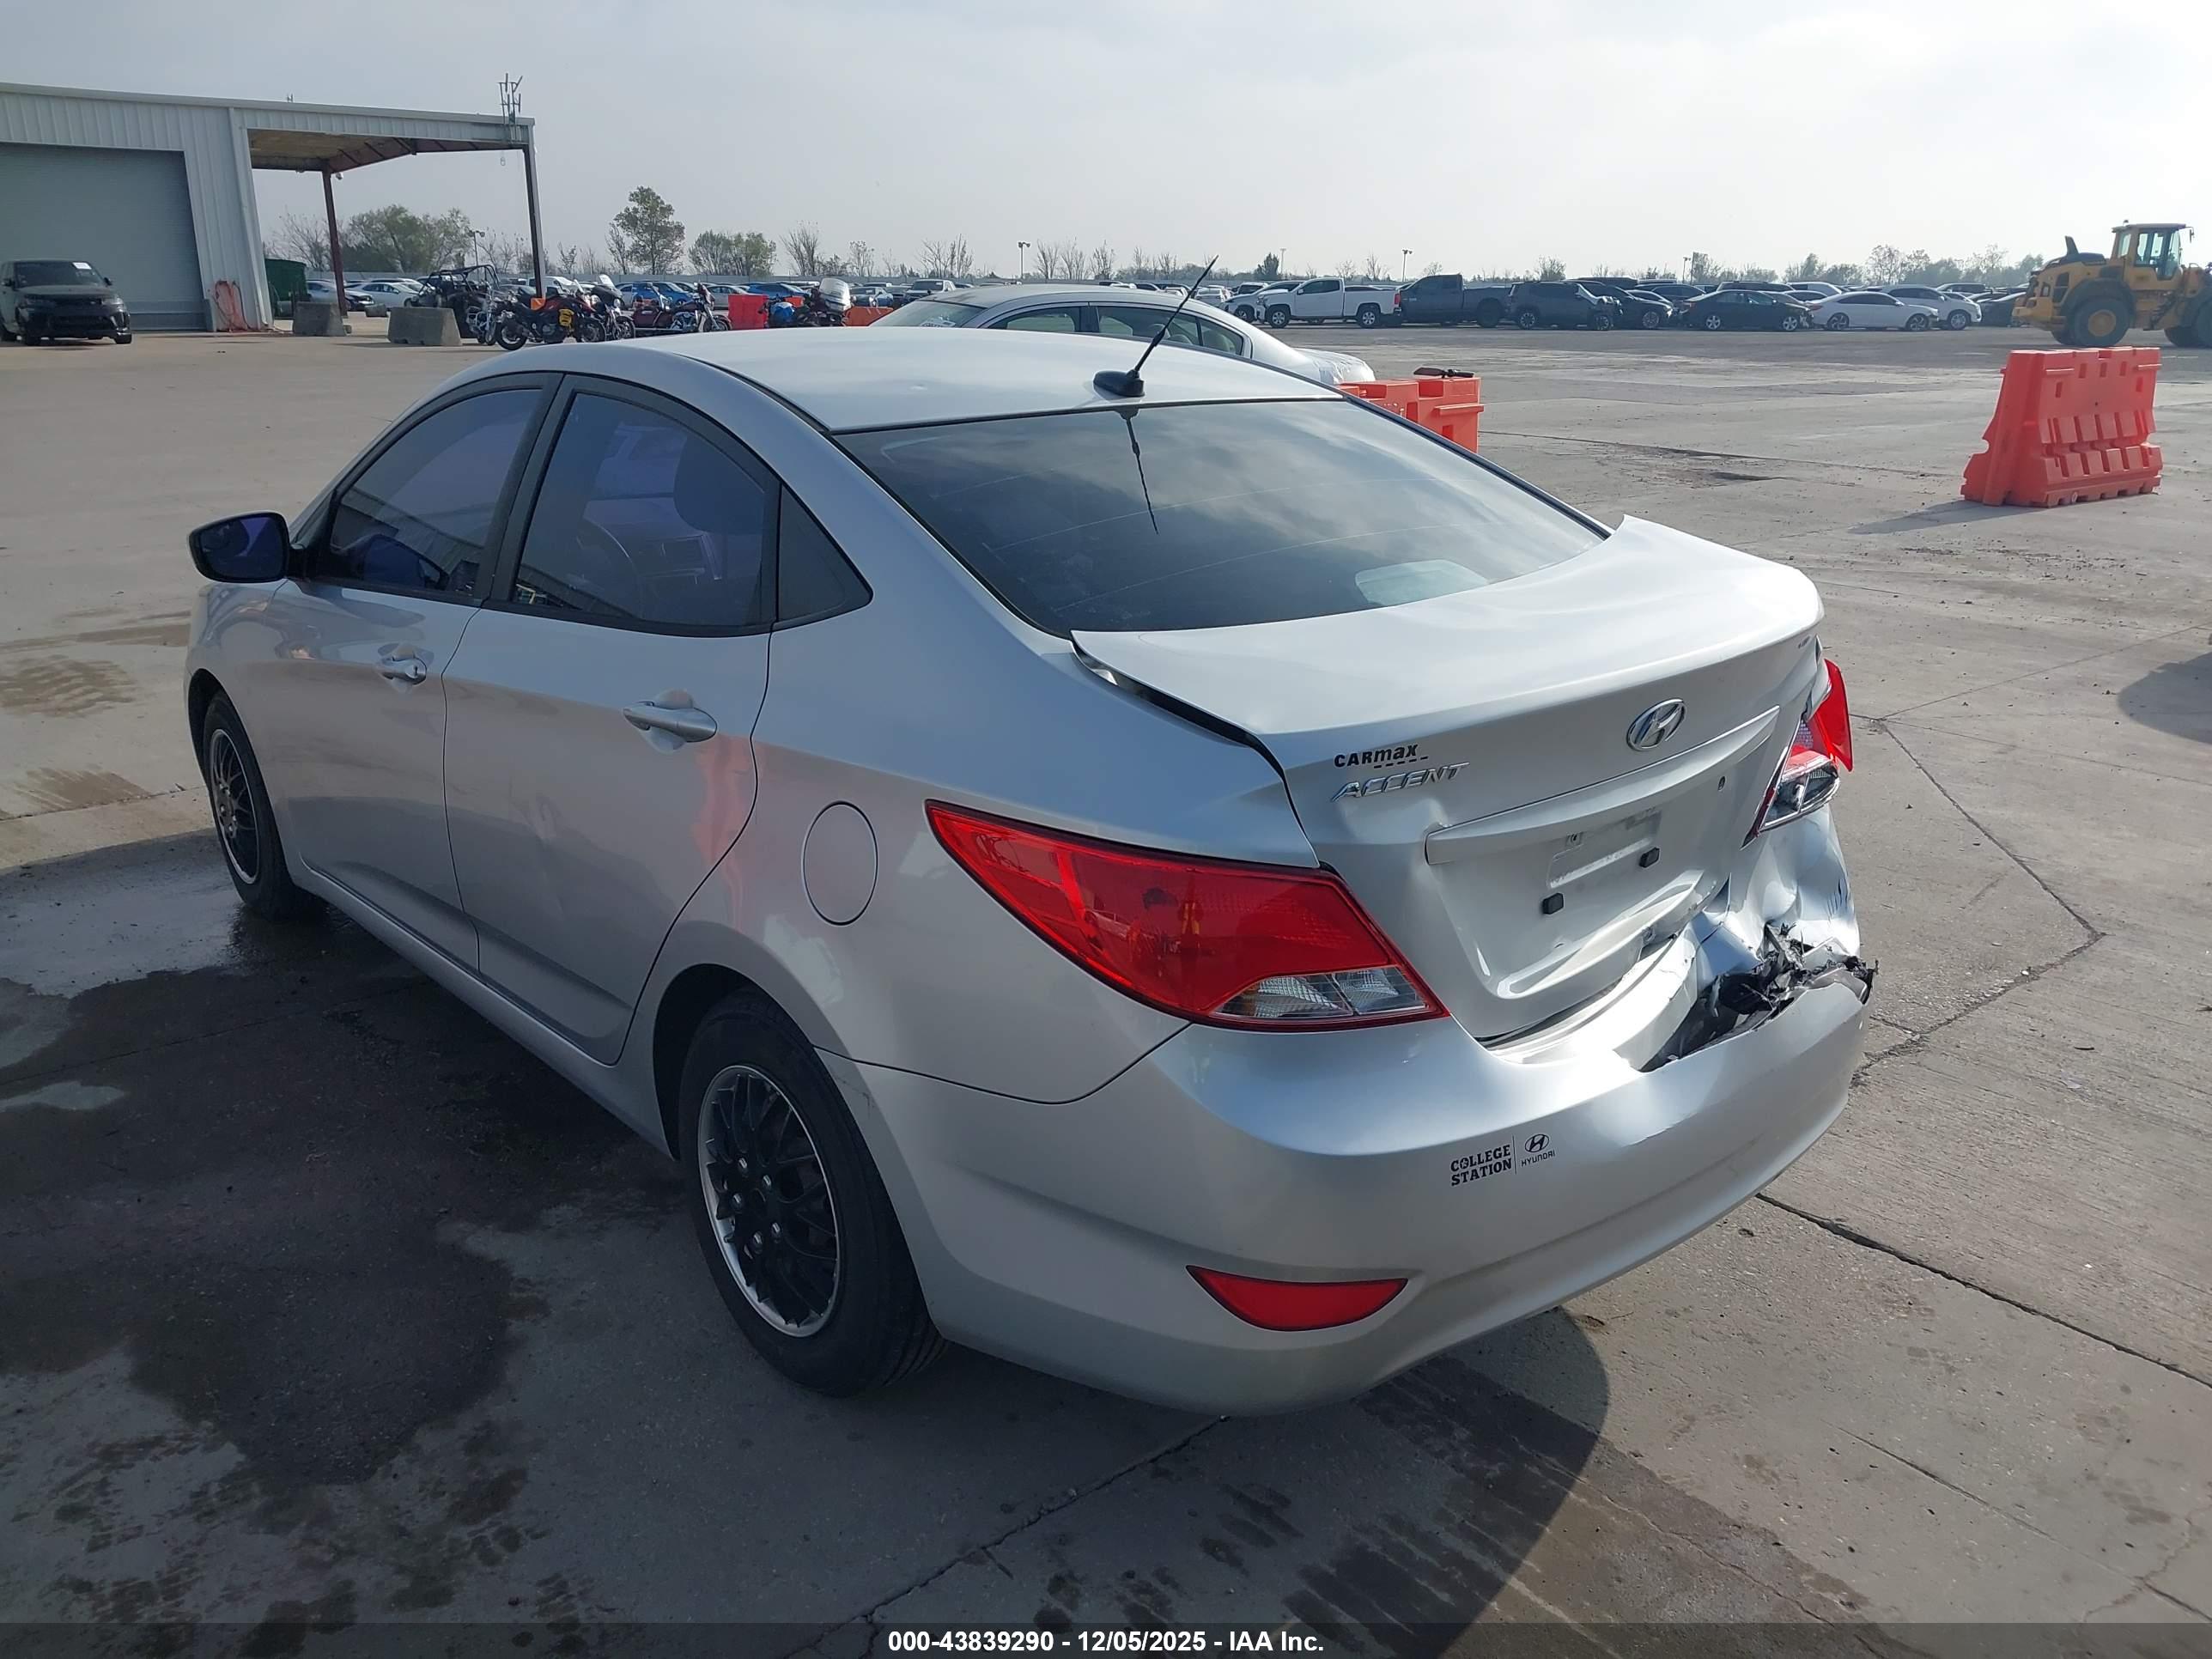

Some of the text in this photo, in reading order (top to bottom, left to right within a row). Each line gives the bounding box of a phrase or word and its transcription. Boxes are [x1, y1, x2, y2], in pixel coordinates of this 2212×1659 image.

[1331, 763, 1470, 802] ACCENT
[1450, 1144, 1511, 1171] COLLEGE
[1521, 1150, 1556, 1166] HYUNDAI
[1450, 1158, 1512, 1187] STATION
